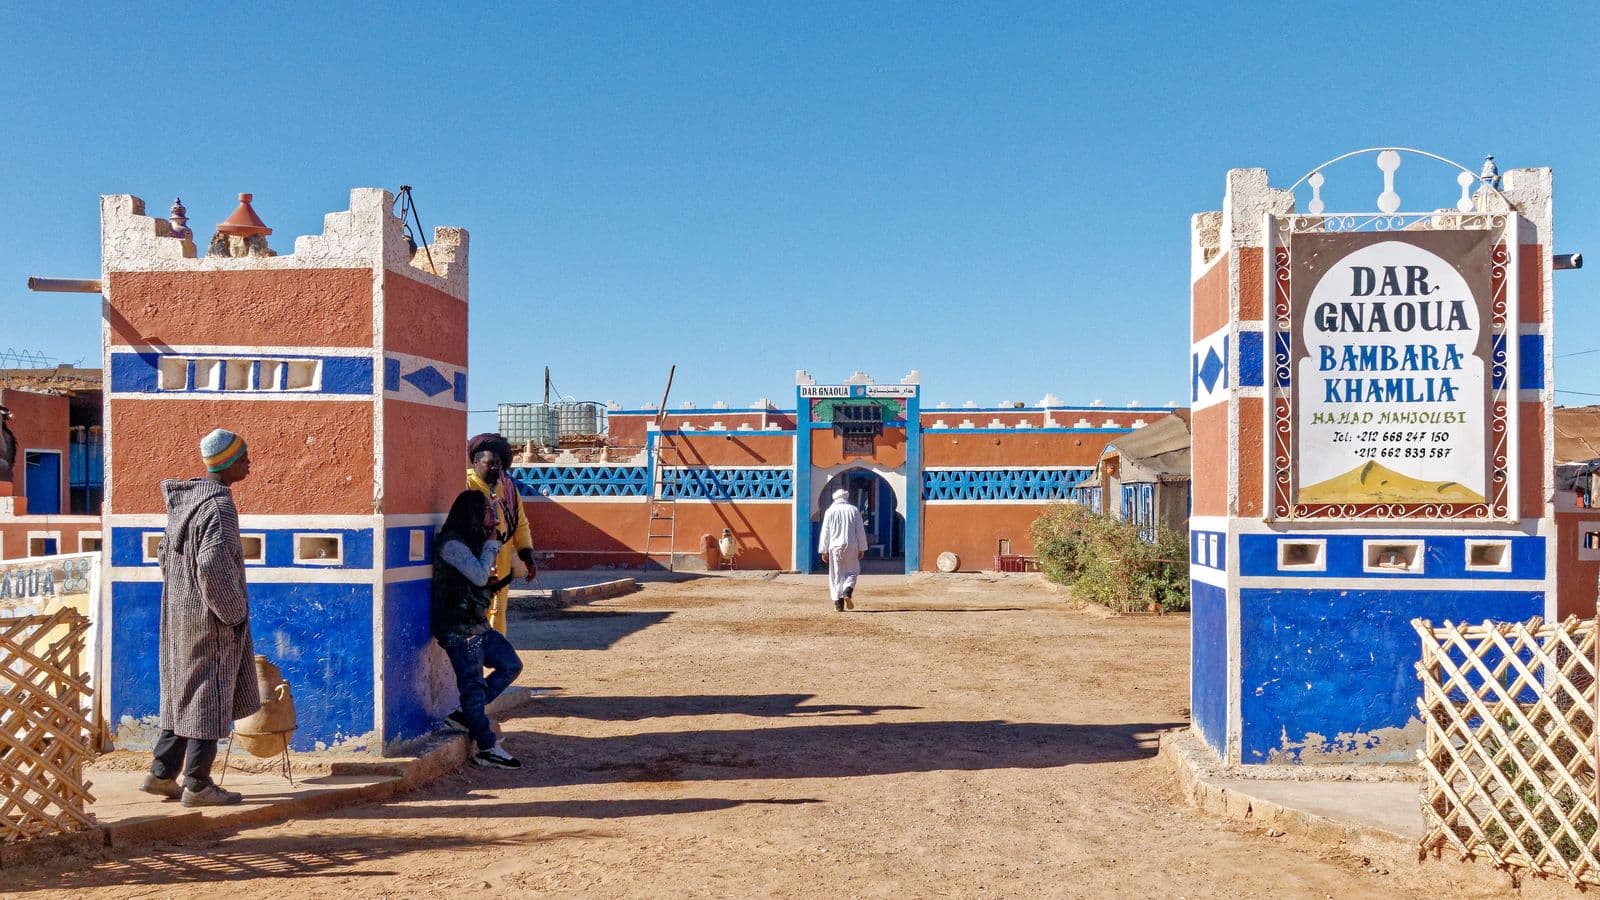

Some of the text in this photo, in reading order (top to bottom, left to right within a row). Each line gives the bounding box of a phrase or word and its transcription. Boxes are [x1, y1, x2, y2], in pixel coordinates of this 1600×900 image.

[1350, 265, 1439, 297] DAR
[1314, 300, 1472, 333] GNAOUA
[1318, 344, 1464, 372] BAMBARA
[802, 387, 849, 396] DAR GNAOUA
[1323, 377, 1459, 404] KHAMLIA
[1377, 411, 1468, 425] MAHJOUBI
[1332, 431, 1450, 443] Tel: +212 668 247 150
[1354, 447, 1453, 459] +212 662 839 587
